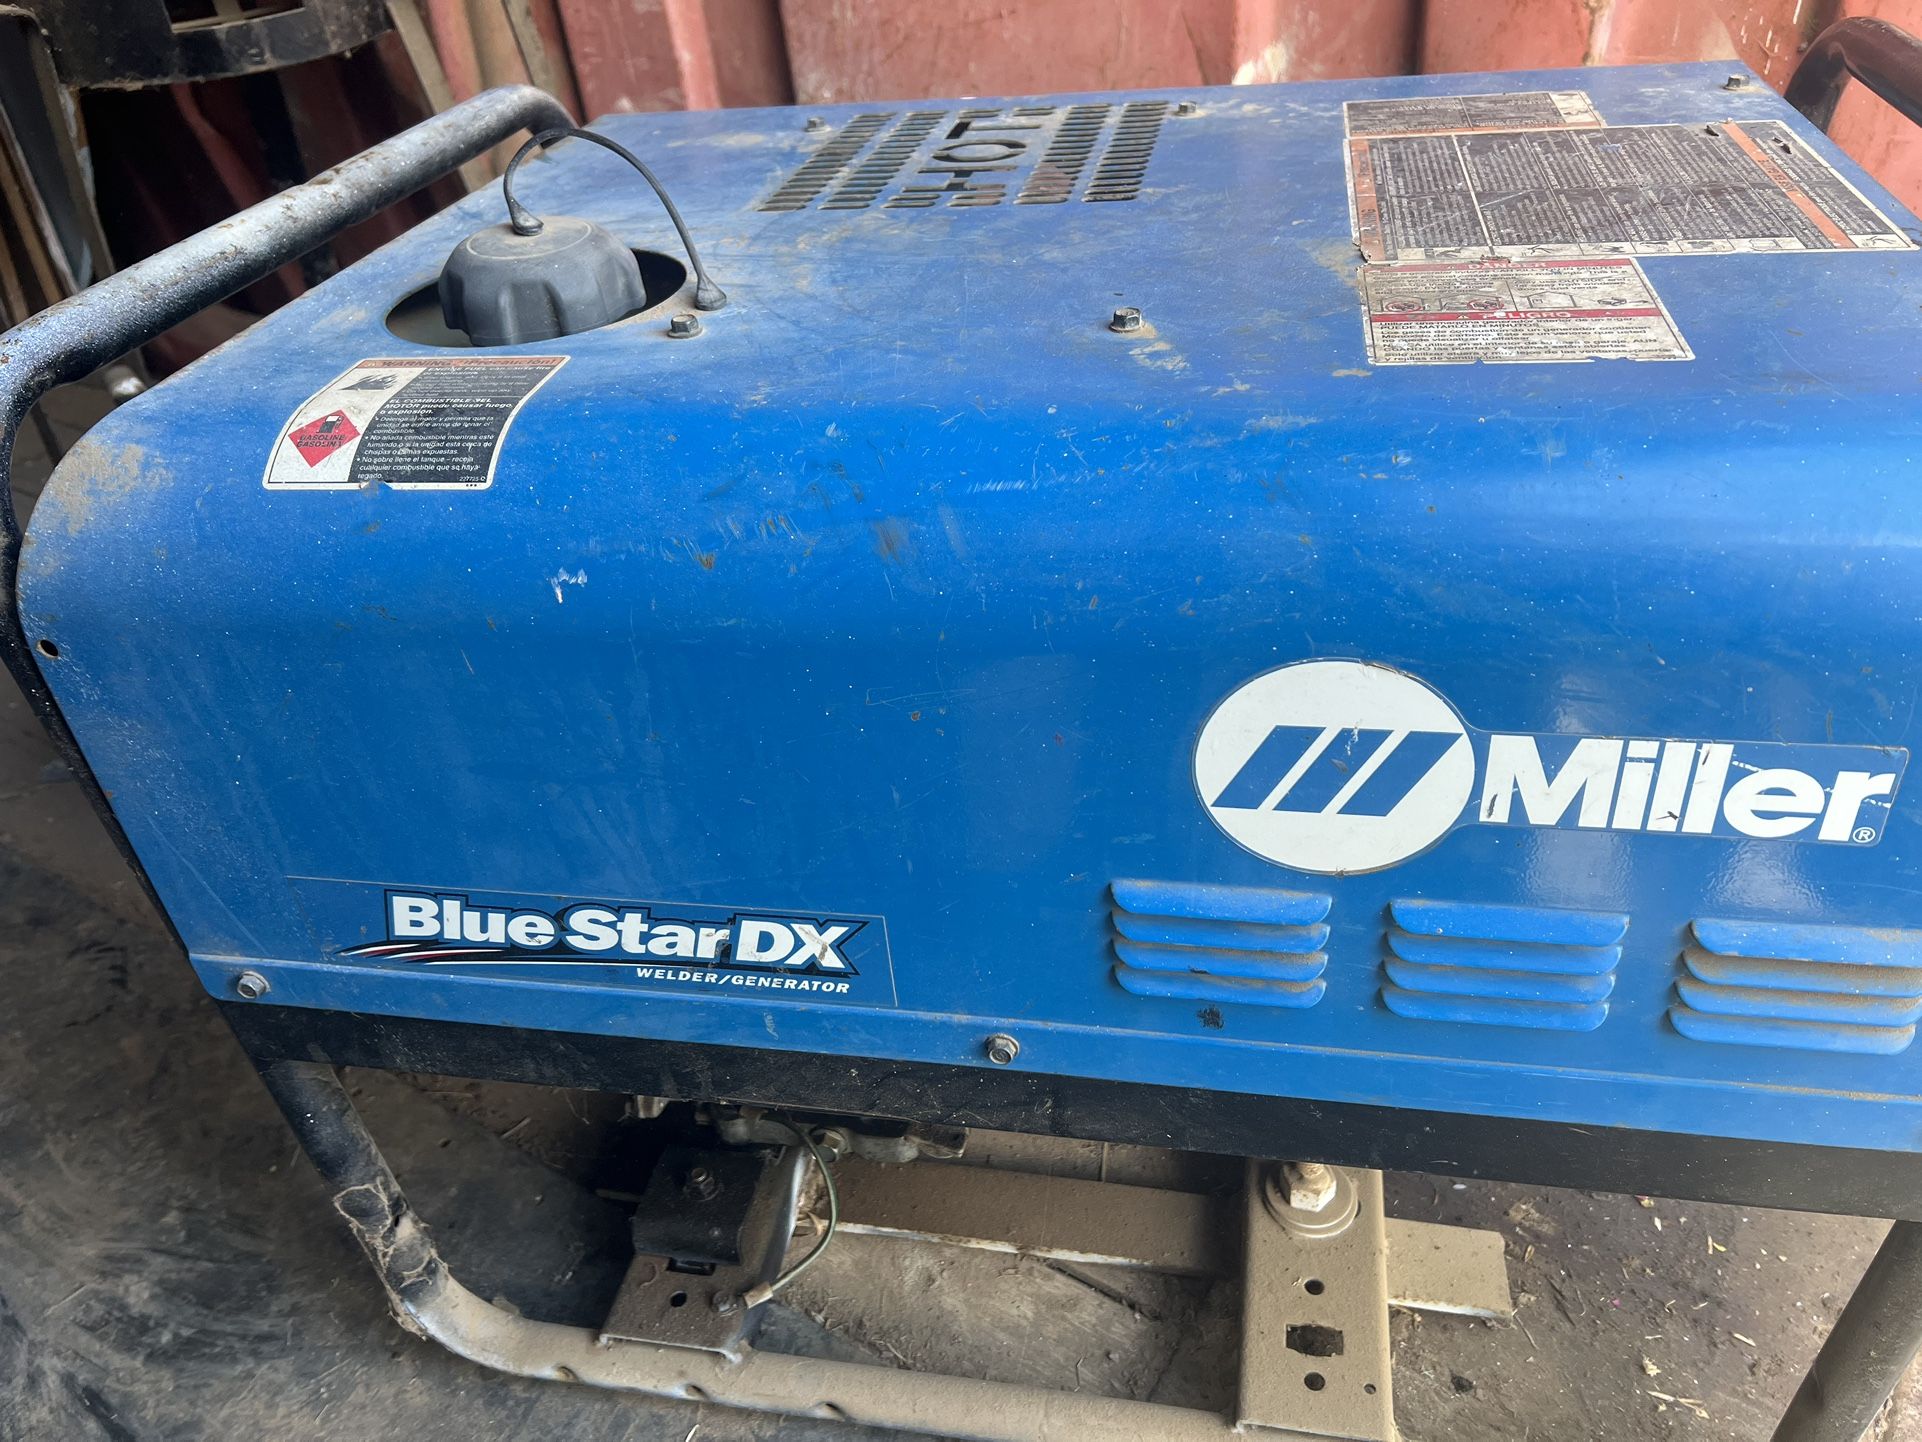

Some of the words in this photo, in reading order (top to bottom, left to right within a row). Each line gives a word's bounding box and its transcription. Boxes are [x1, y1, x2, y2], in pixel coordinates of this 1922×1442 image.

[1478, 734, 1896, 842] Miller
[391, 895, 555, 947] Blue
[566, 909, 730, 959] Star
[735, 920, 851, 969] DX
[636, 967, 851, 994] WELDER/GENERATOR
